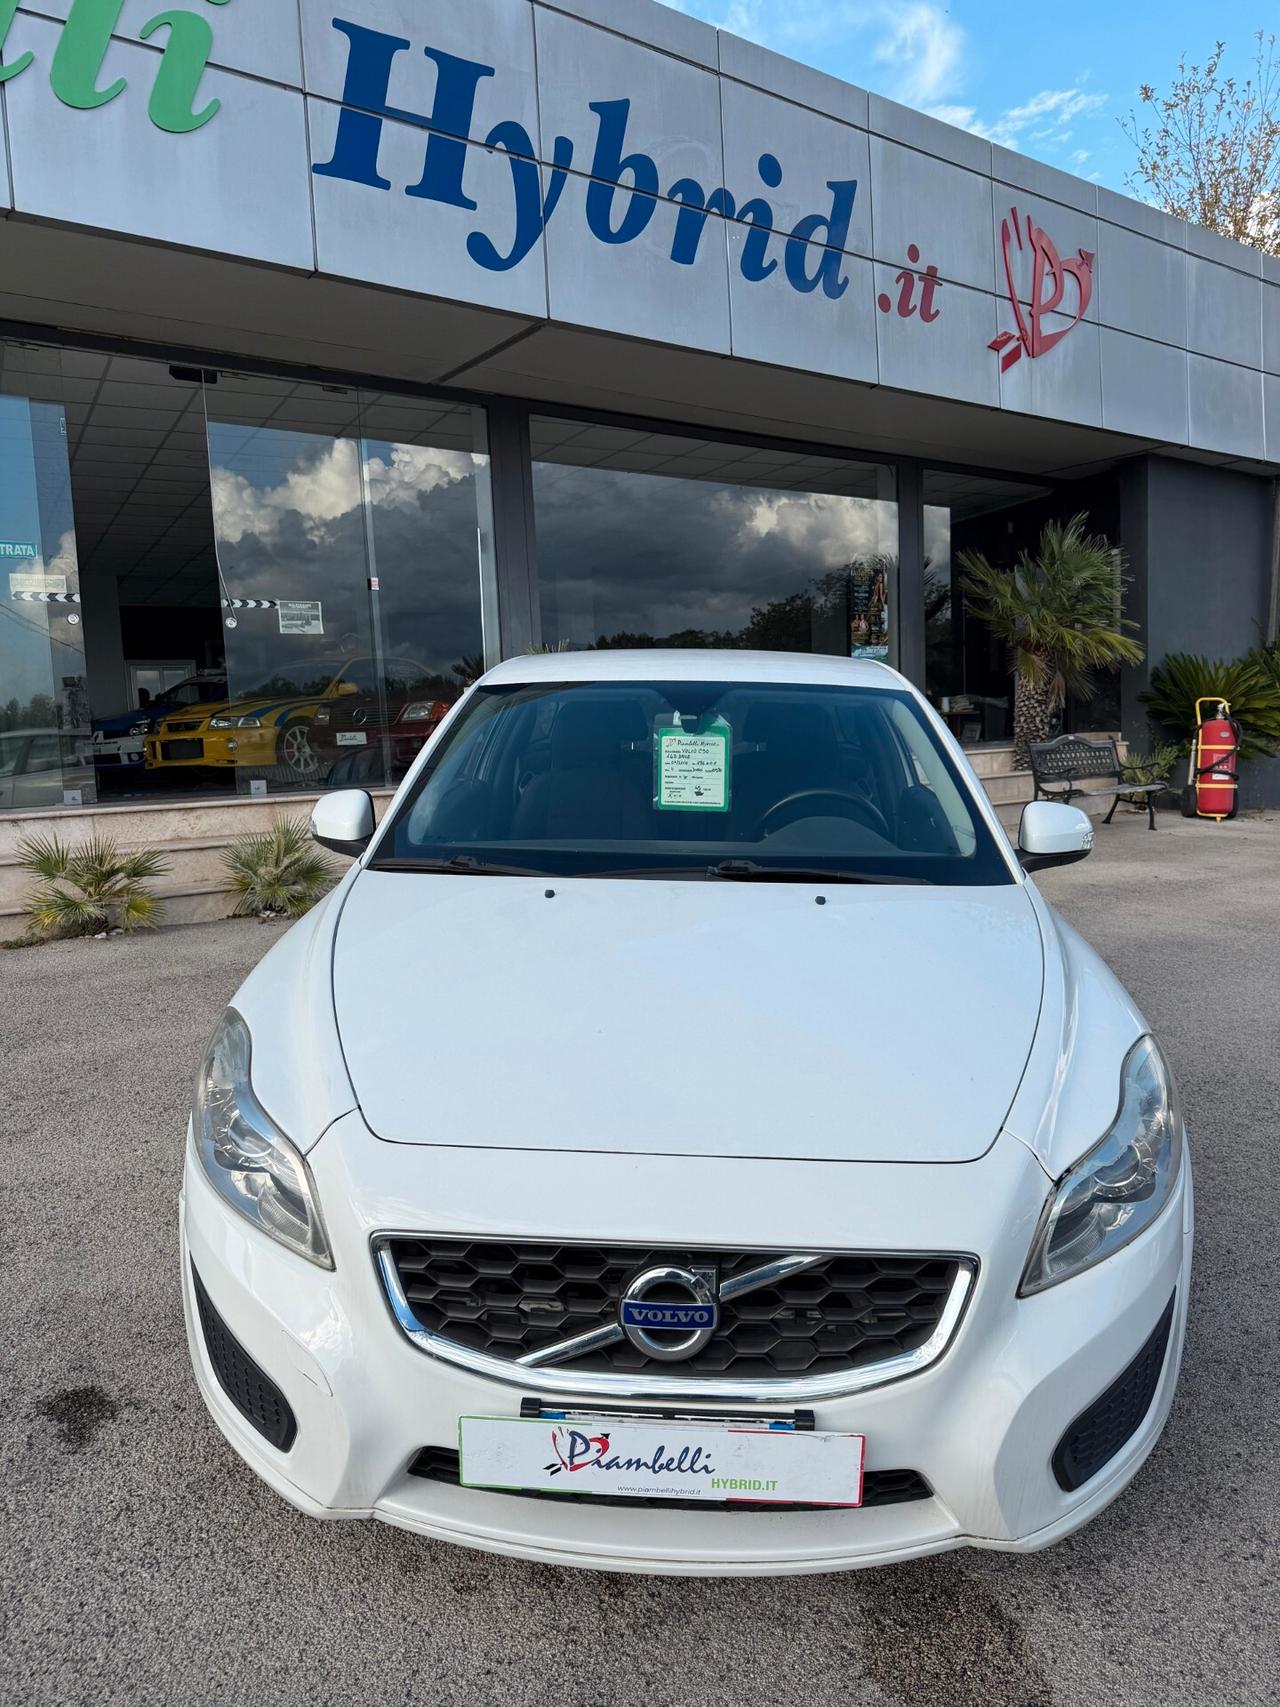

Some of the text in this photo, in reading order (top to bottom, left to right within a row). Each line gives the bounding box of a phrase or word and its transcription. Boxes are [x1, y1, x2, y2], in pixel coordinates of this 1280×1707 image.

[0, 544, 35, 556] TRATA
[629, 1307, 709, 1323] VOLVO
[567, 1429, 715, 1475] Piambelli
[617, 1484, 701, 1496] www.piambellihybrid.it
[711, 1477, 778, 1491] HYBRID.IT
